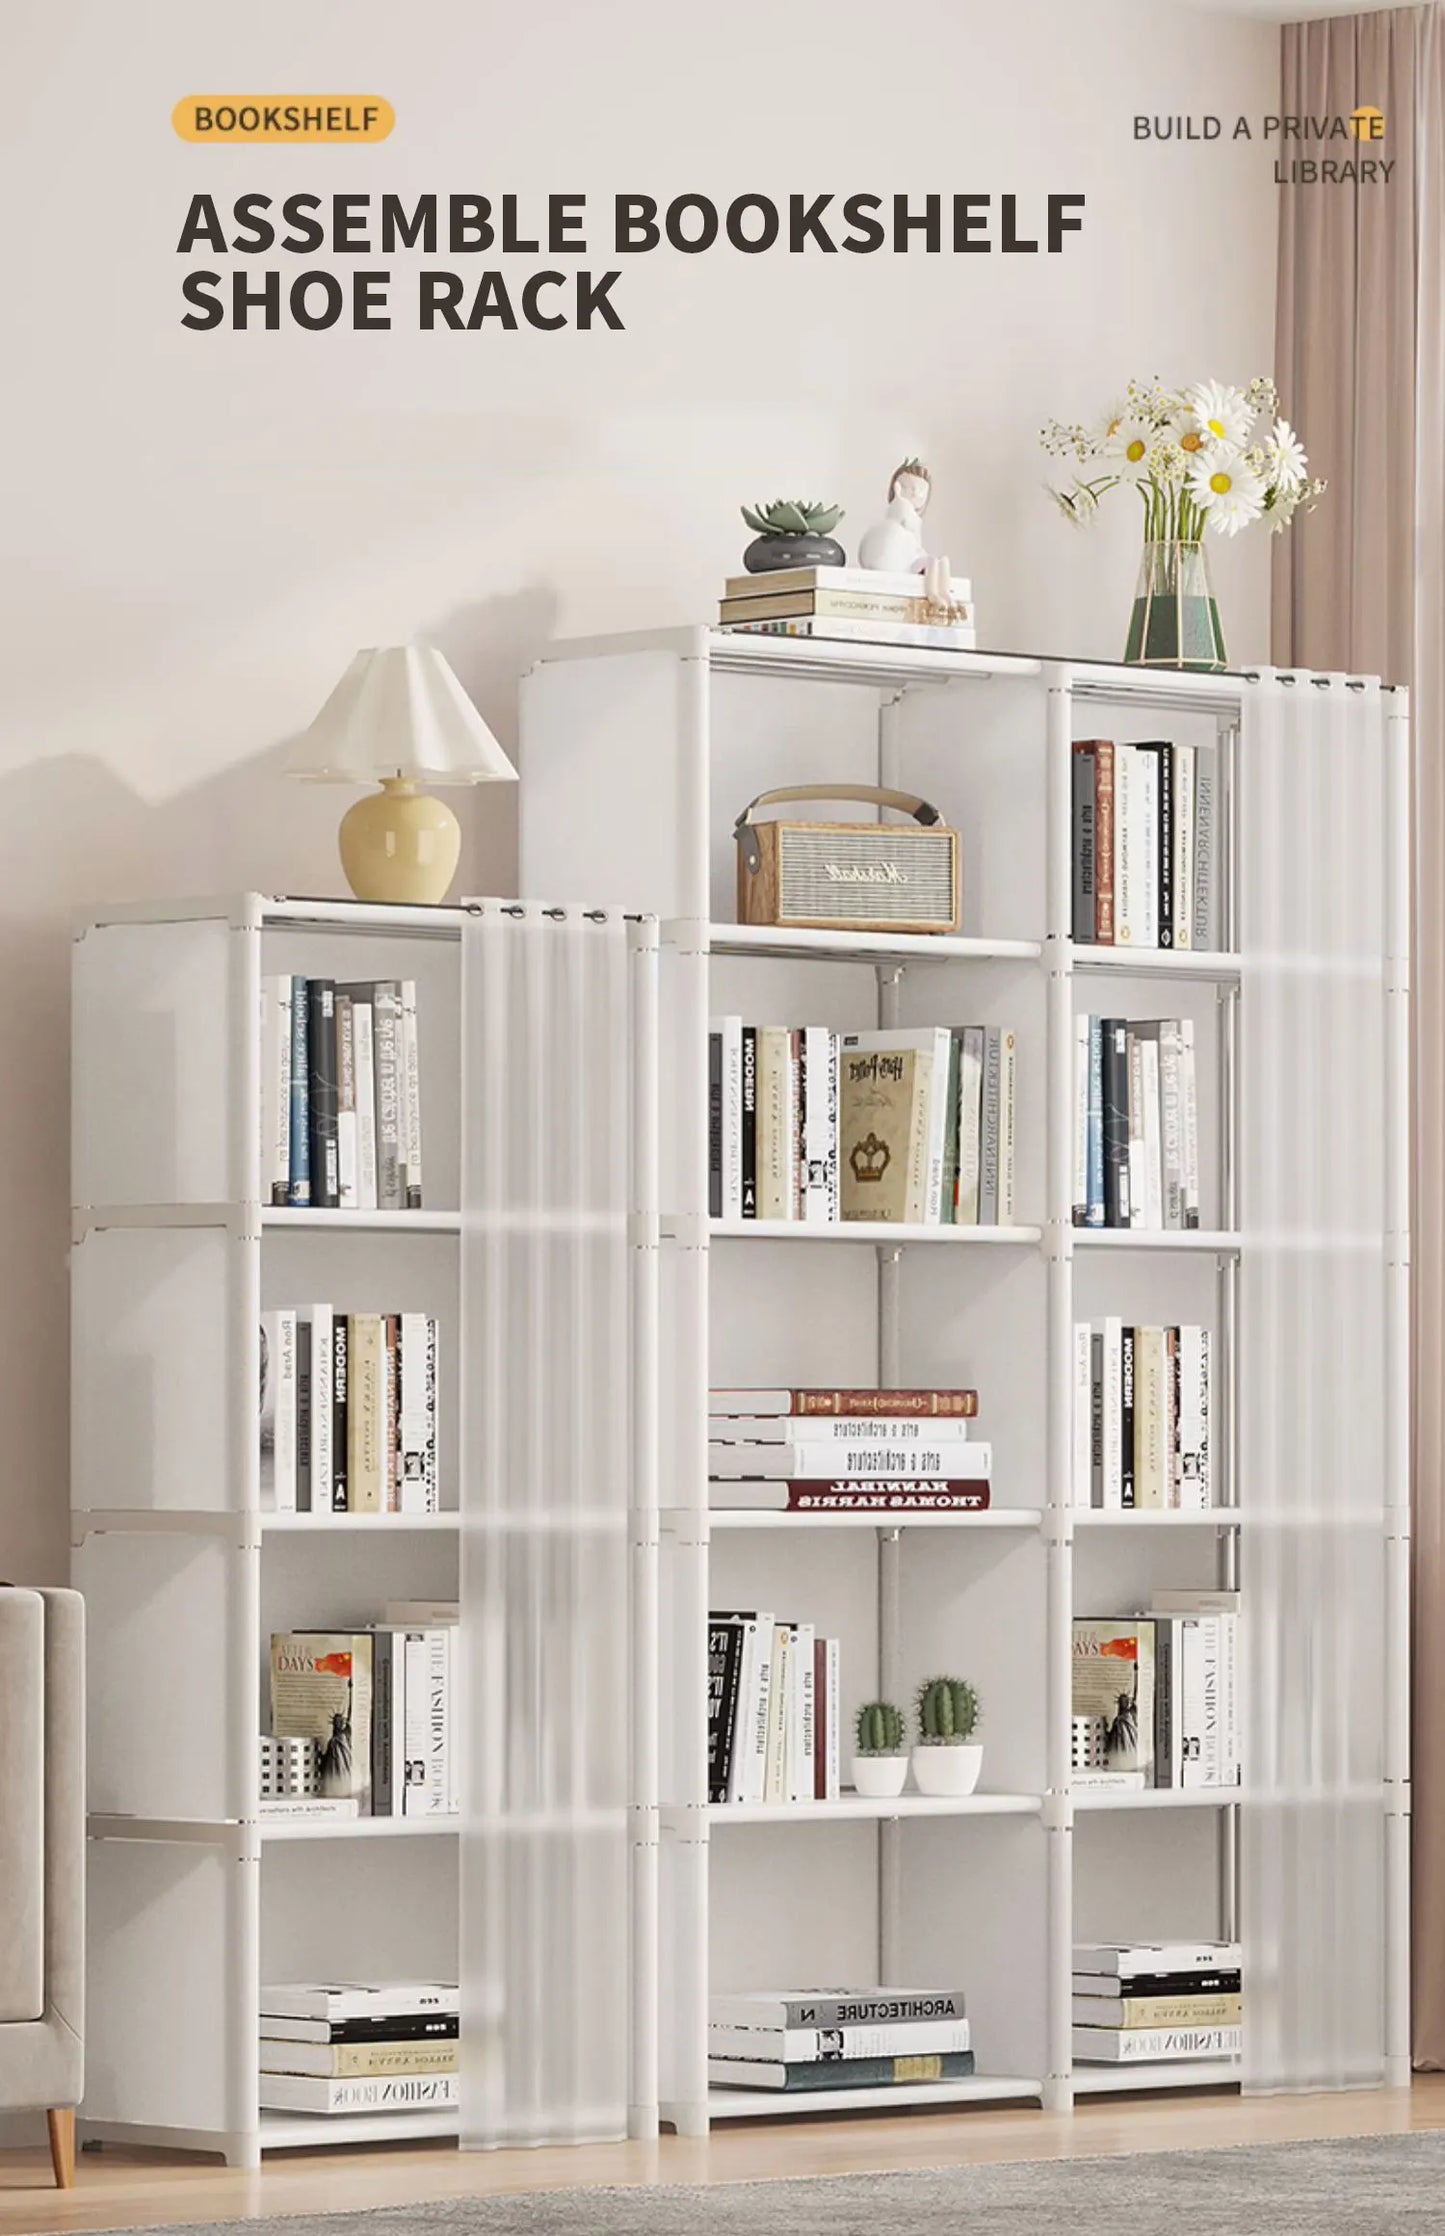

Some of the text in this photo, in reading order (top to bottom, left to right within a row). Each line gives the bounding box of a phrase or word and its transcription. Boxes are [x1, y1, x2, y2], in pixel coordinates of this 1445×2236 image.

[278, 1657, 313, 1671] DAYS
[1073, 1642, 1098, 1655] AYS
[1206, 1659, 1216, 1730] FASHION
[431, 1635, 444, 1809] THE FASHION BOOK
[1205, 1735, 1216, 1781] BOOK
